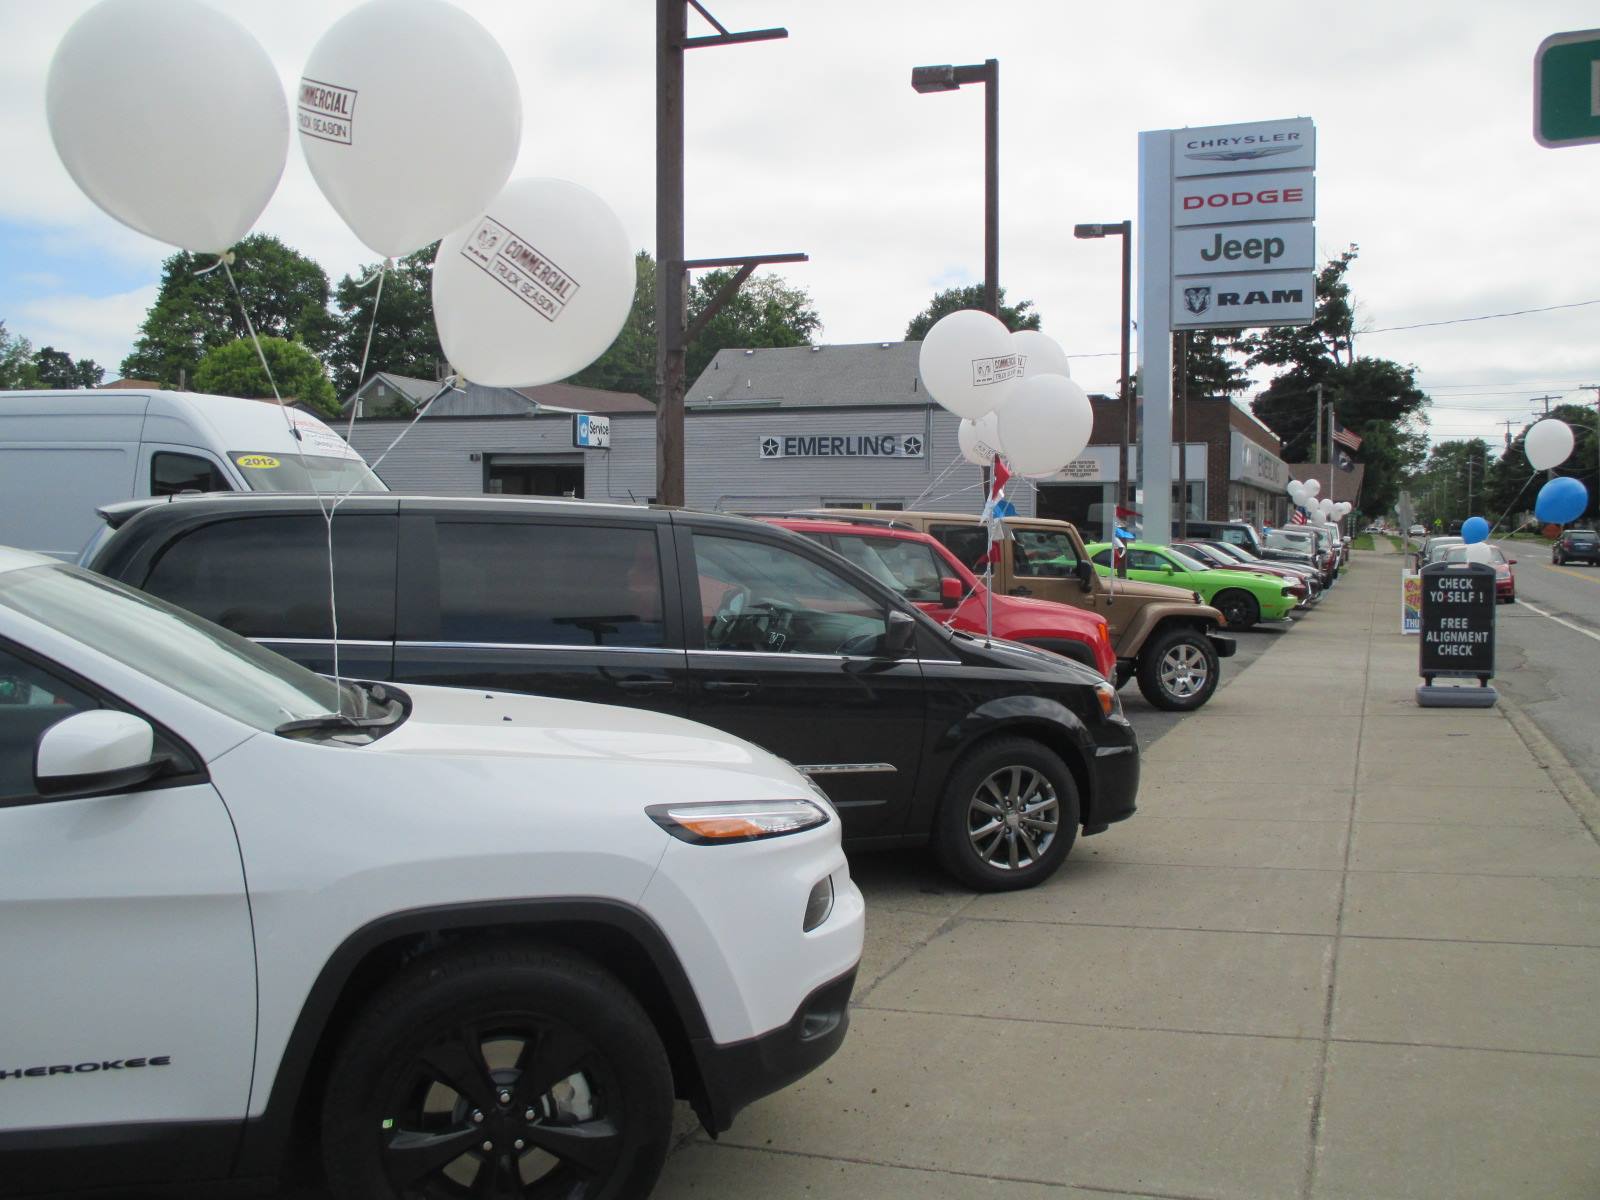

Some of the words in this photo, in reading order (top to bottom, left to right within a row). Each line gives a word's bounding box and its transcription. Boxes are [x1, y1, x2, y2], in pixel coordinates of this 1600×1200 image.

[1186, 132, 1301, 149] CHRYSLER
[1183, 188, 1303, 210] DODGE
[1200, 233, 1285, 264] Jeep
[504, 239, 571, 300] COMMERCIAL
[493, 259, 522, 288] TRUCK
[519, 282, 557, 315] SEASON
[1217, 289, 1303, 306] RAM
[589, 420, 609, 435] Service
[784, 436, 896, 456] EMERLING
[244, 457, 276, 466] 2012
[1438, 578, 1473, 590] CHECK
[1430, 591, 1443, 602] YO
[1447, 591, 1475, 603] SELF
[1440, 618, 1469, 629] FREE
[1426, 631, 1489, 643] ALIGNMENT
[1437, 644, 1473, 656] CHECK
